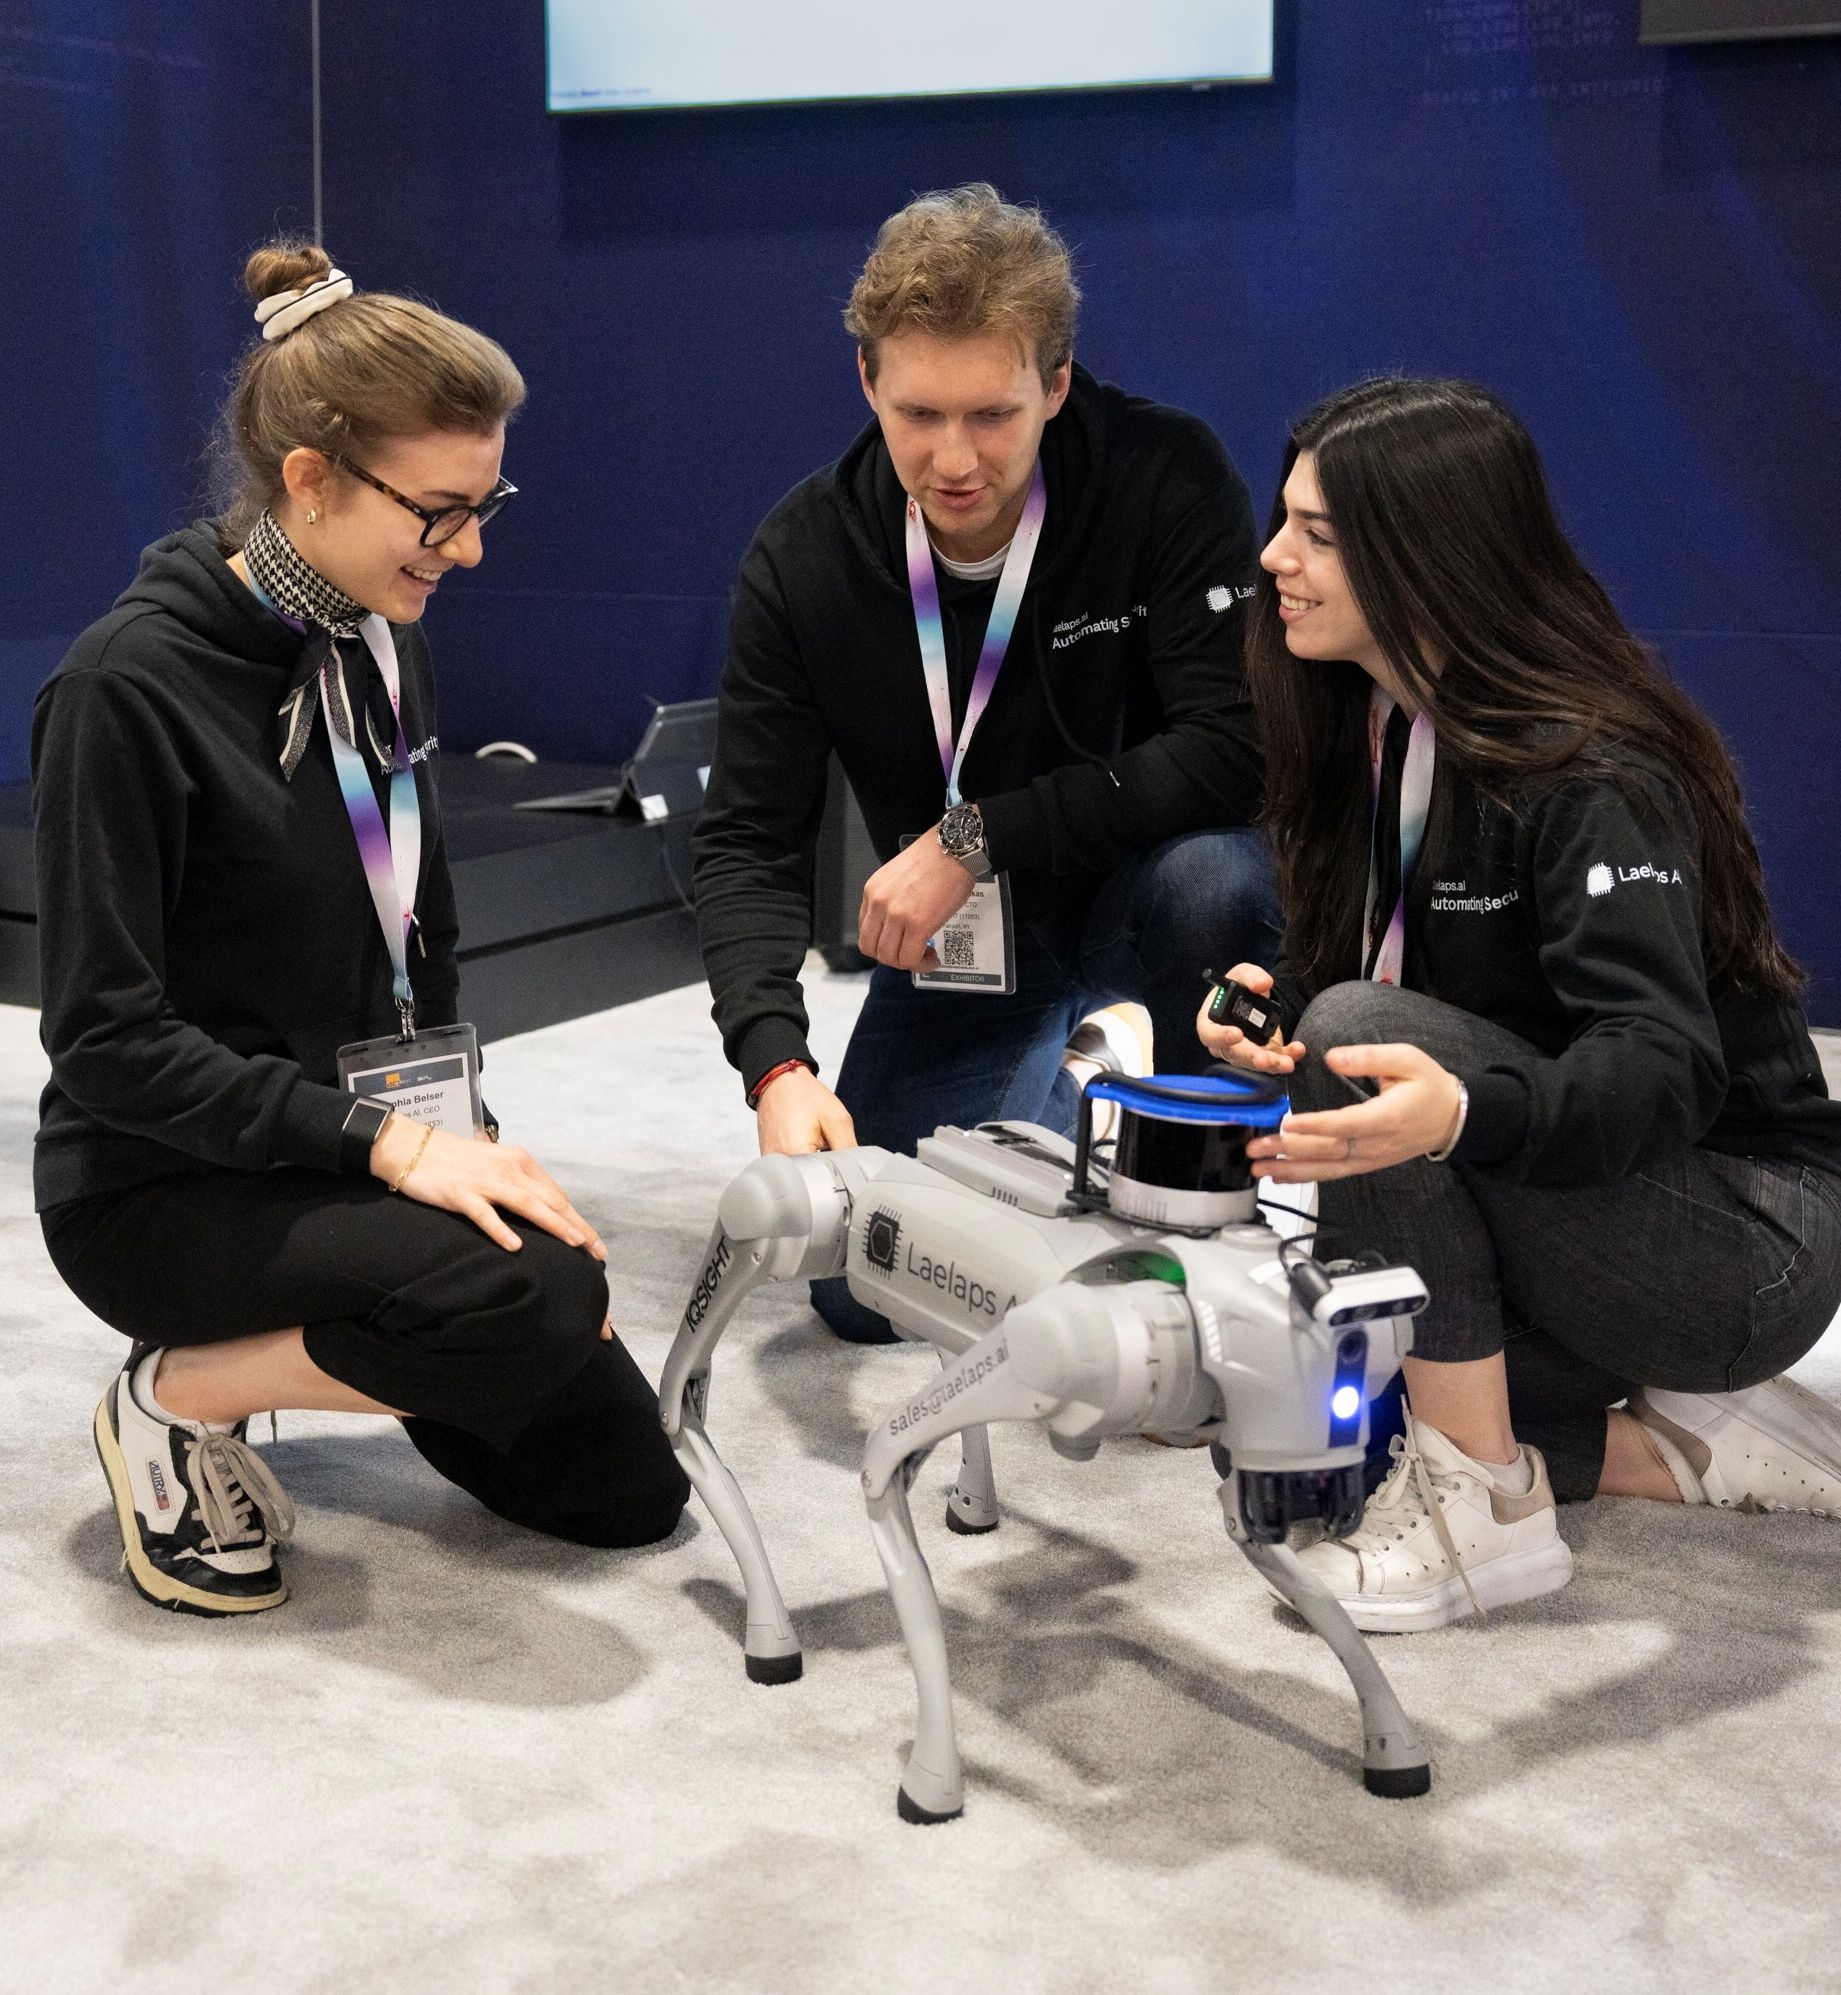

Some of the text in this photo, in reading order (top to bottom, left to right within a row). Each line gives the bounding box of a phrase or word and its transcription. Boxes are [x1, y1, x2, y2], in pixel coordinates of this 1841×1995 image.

[1052, 618, 1119, 650] Automating
[1431, 889, 1519, 915] Automating Secu
[951, 974, 985, 982] EXHIBITOR
[392, 1091, 444, 1108] phia Belser
[424, 1105, 440, 1114] CEO
[685, 1235, 731, 1334] IQSIGHT
[907, 1241, 998, 1316] Laelaps
